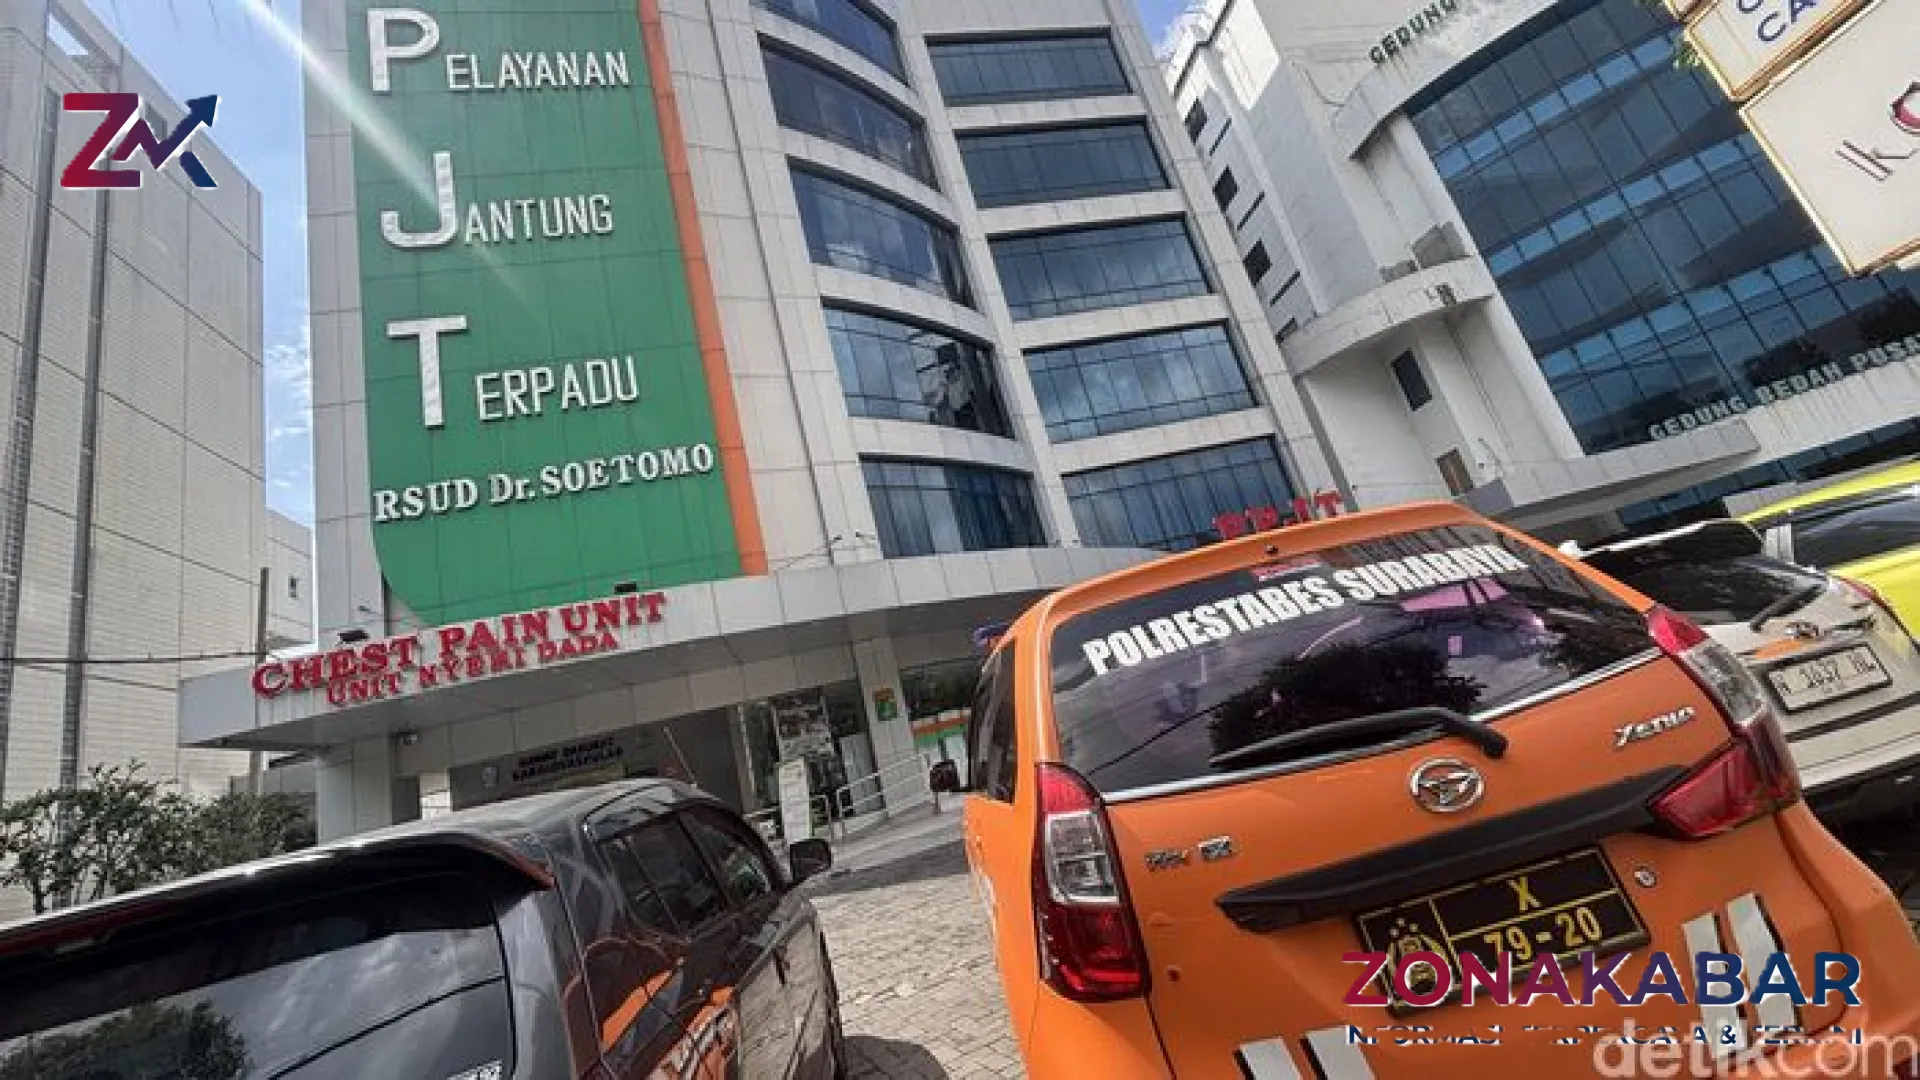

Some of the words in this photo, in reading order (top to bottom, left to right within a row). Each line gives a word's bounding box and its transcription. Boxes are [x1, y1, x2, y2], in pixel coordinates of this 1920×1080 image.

[367, 8, 630, 92] PELAYANAN
[380, 152, 614, 247] JANTUNG
[387, 315, 639, 426] TERPADU
[1648, 394, 1748, 440] GEDUNG
[373, 478, 478, 521] RSUD
[488, 473, 536, 503] Dr.
[540, 443, 714, 495] SOETOMO
[252, 636, 418, 697] CHEST
[438, 609, 550, 662] PAIN
[559, 592, 666, 632] UNIT
[1083, 575, 1345, 675] POLRESTABES
[1332, 544, 1529, 600] SURABAYA
[326, 673, 398, 704] UNIT
[537, 632, 618, 663] DADA
[1508, 876, 1542, 911] X
